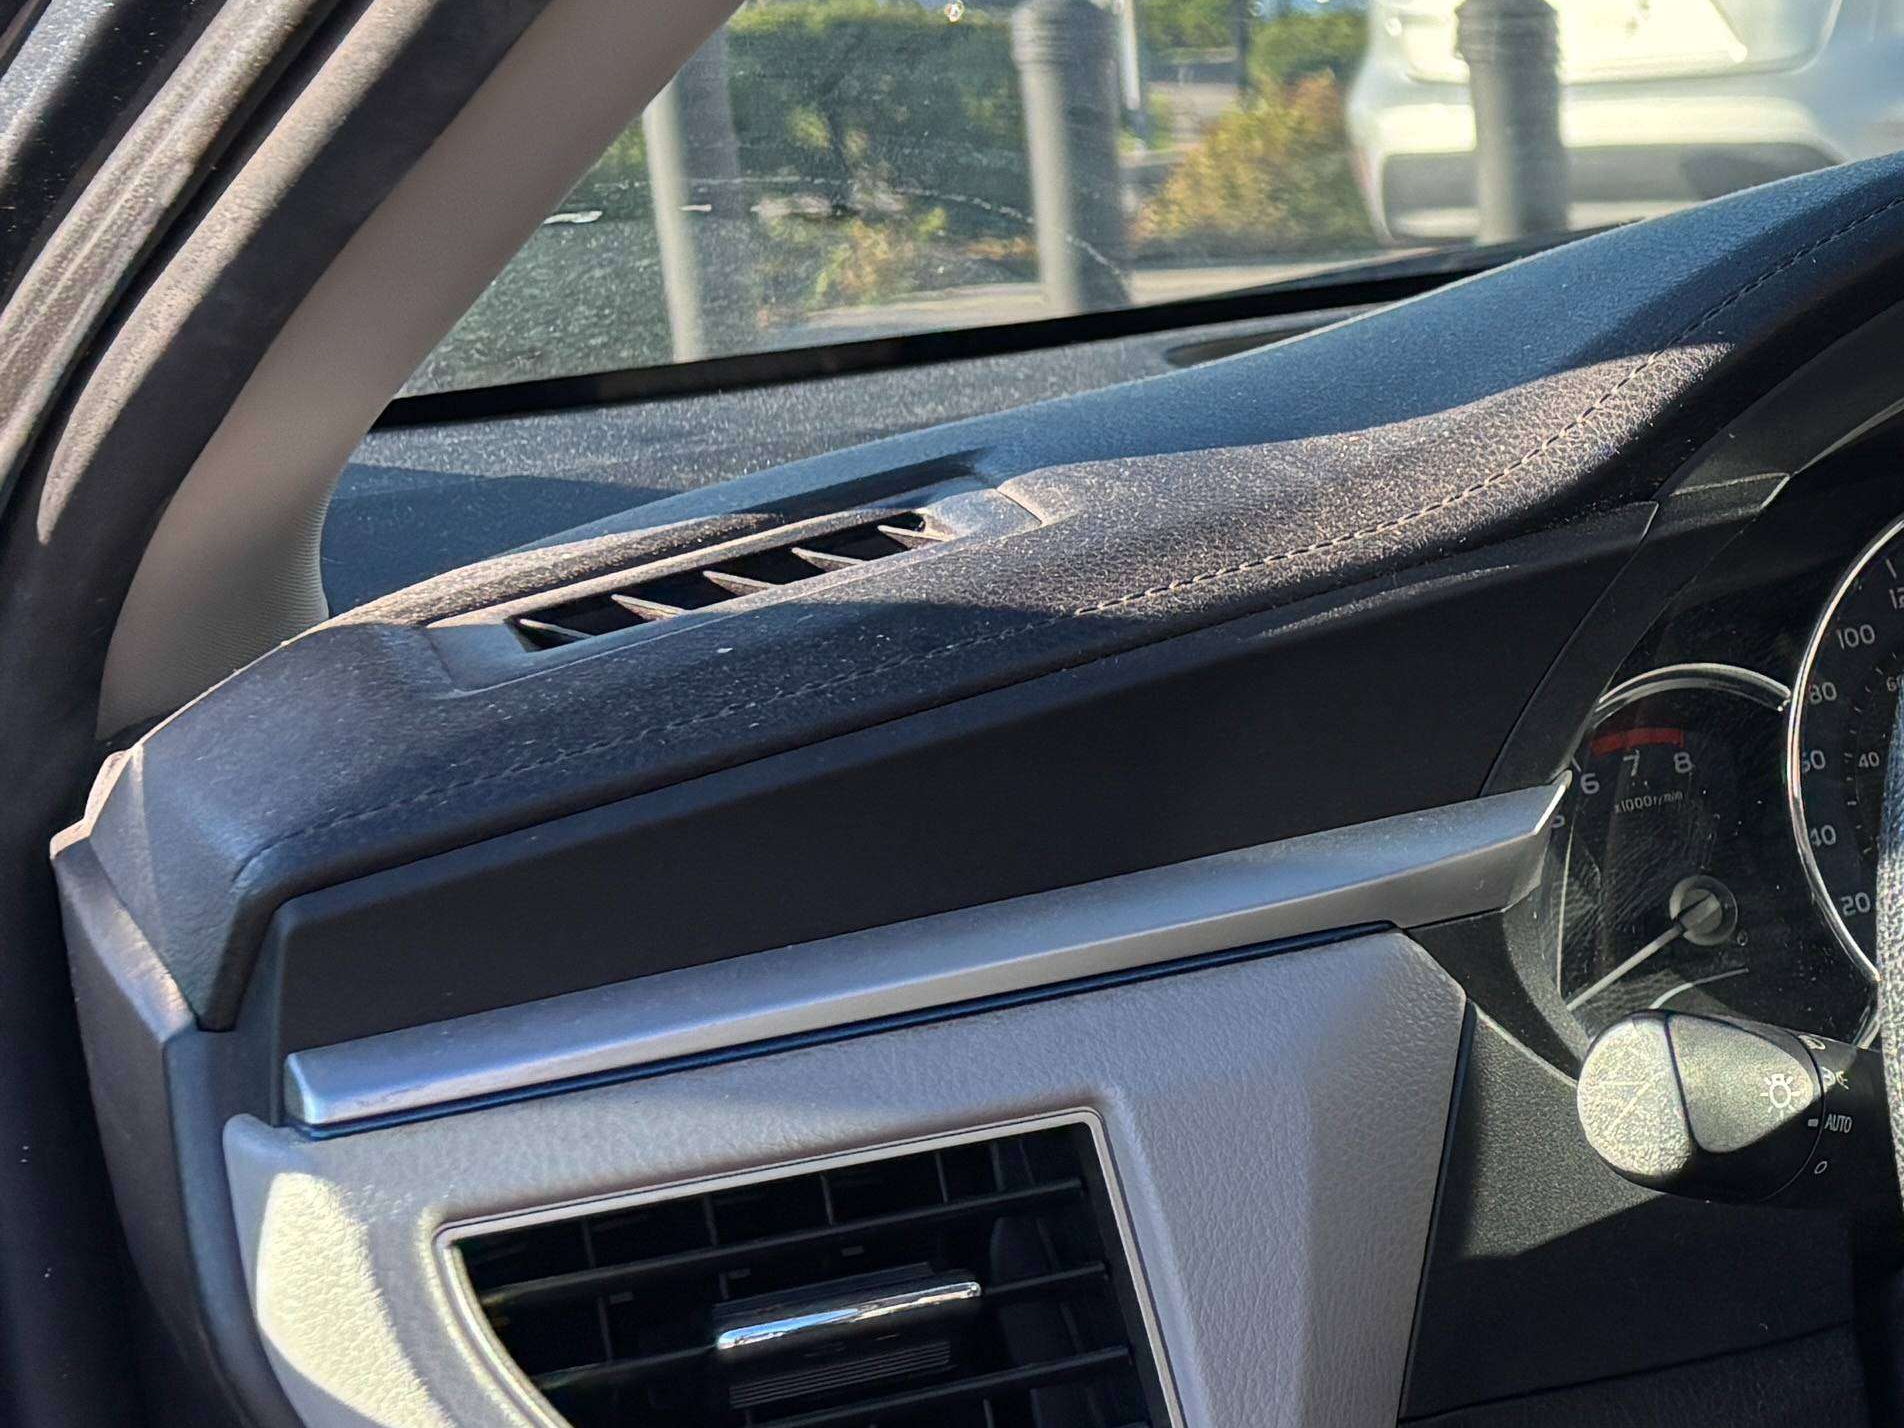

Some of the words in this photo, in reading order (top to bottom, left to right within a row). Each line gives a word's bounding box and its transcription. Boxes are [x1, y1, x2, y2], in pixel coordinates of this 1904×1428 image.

[1836, 624, 1875, 650] 100
[1808, 682, 1837, 704] 80
[1623, 749, 1640, 776] 7
[1673, 751, 1694, 773] 8
[1858, 751, 1880, 768] 40
[1580, 773, 1599, 794] 6
[1841, 892, 1870, 917] 20
[1824, 1113, 1852, 1133] AUTO
